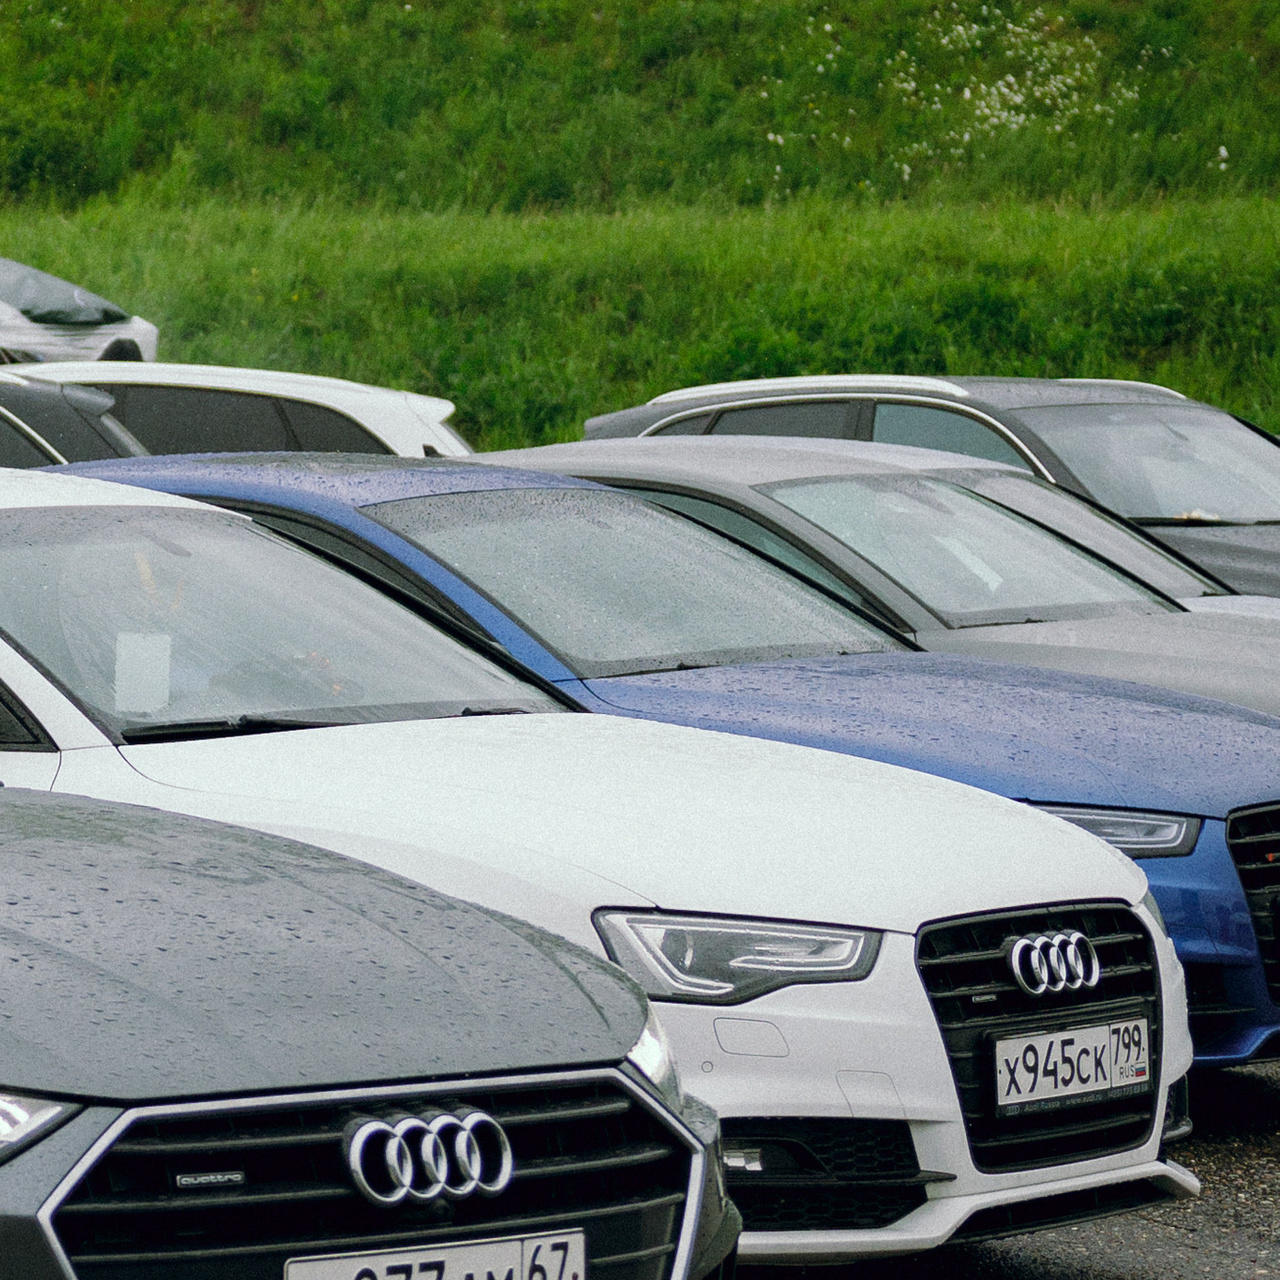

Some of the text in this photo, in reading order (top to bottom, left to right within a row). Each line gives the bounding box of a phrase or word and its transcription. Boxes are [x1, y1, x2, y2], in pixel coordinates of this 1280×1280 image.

[1111, 1023, 1142, 1065] 799
[1119, 1064, 1135, 1080] RUS
[180, 1173, 243, 1186] quattro
